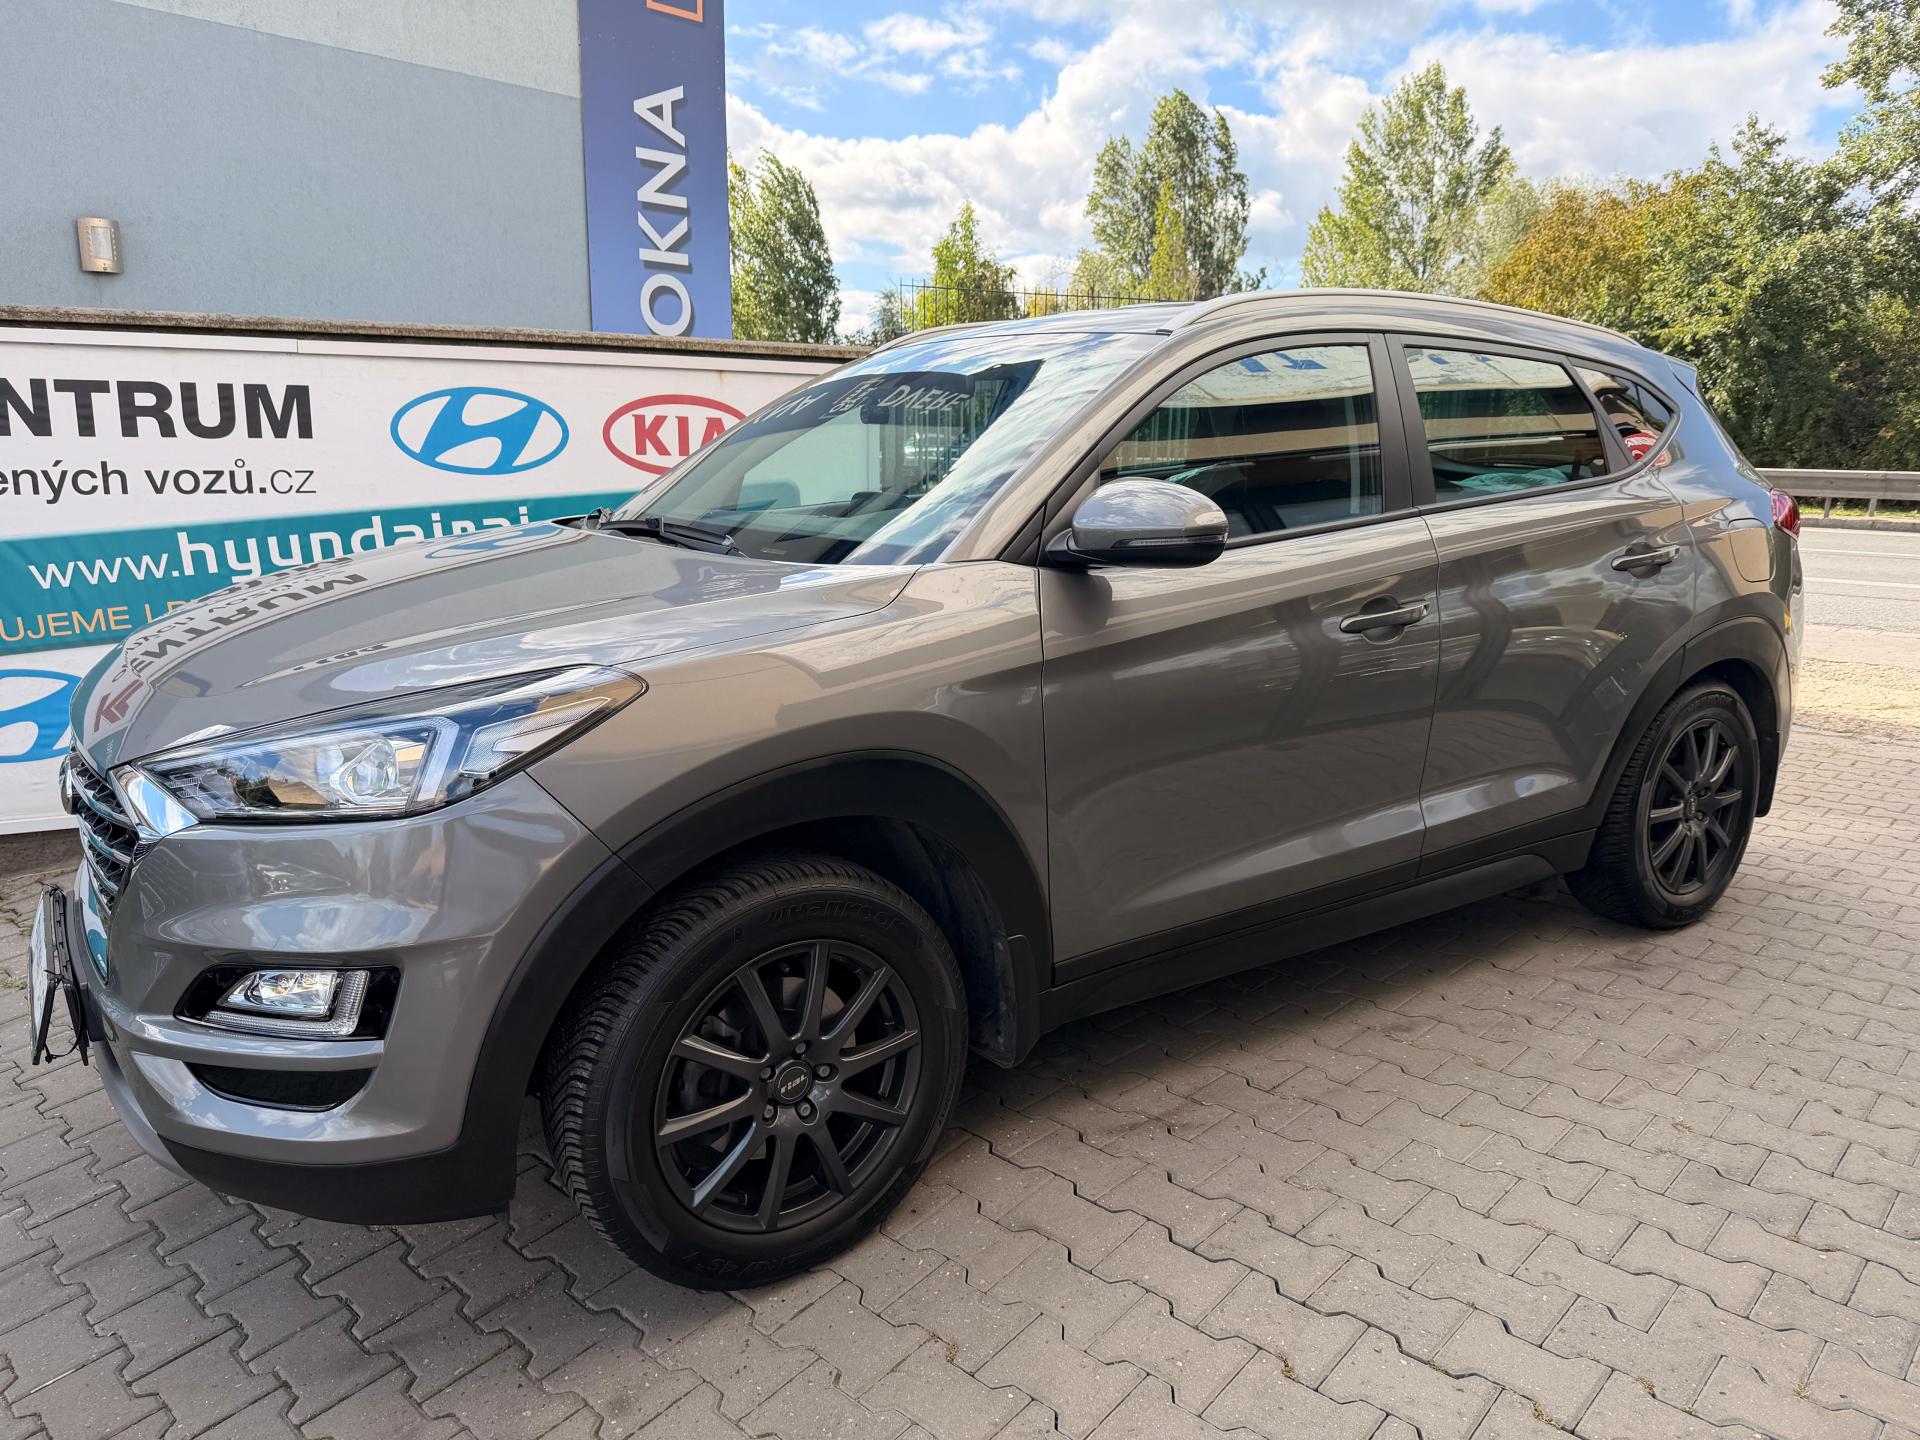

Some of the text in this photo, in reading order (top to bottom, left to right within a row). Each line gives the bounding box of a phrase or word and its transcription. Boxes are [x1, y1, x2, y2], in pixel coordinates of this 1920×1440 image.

[633, 85, 692, 337] OKNA
[0, 377, 313, 439] NTRUM
[632, 413, 717, 457] KIA
[144, 458, 317, 495] vozů.cz
[0, 606, 132, 642] UJEME
